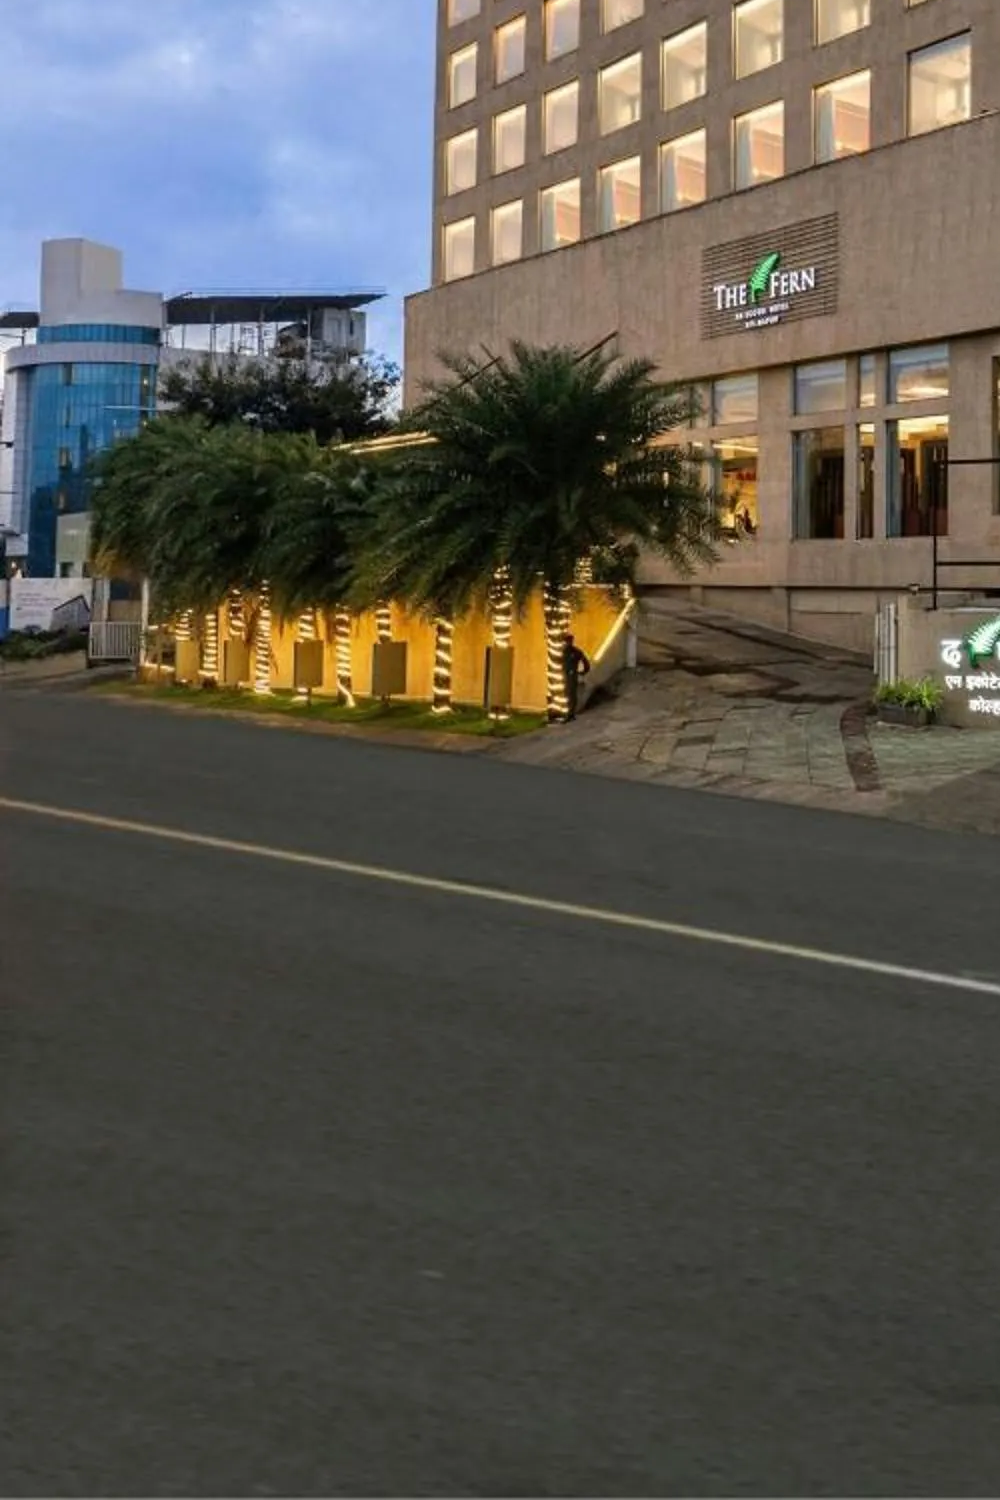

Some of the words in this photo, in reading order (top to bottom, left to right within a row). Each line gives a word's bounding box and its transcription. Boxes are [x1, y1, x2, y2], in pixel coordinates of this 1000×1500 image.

[713, 284, 747, 311] THE
[769, 267, 816, 298] FERN
[940, 639, 962, 668] द
